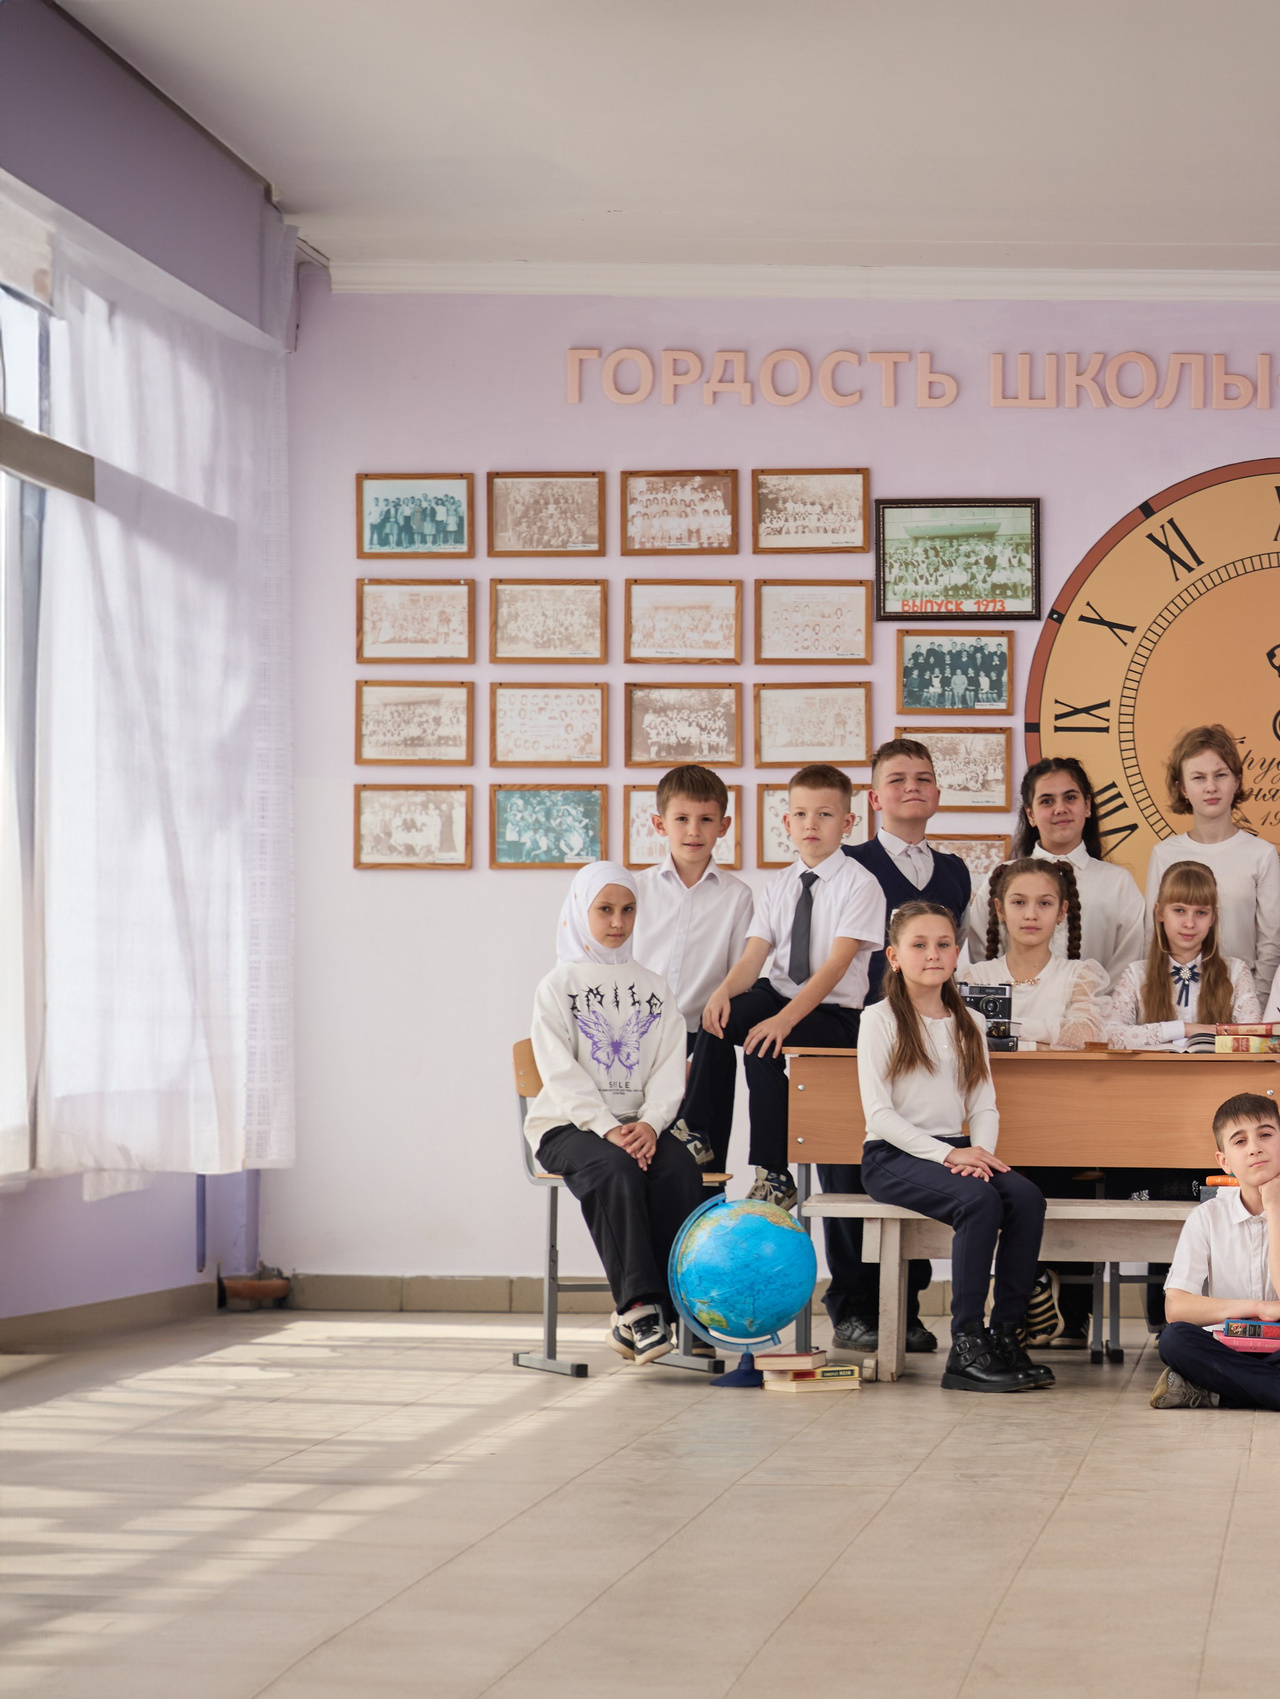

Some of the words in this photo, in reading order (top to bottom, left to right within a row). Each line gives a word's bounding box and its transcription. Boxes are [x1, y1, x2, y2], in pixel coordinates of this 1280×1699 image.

[566, 347, 960, 410] ГОРДОСТЬ
[1145, 517, 1205, 582] XI
[901, 599, 964, 613] ВЫПУСК
[973, 599, 1006, 612] 1973
[1078, 601, 1138, 647] X
